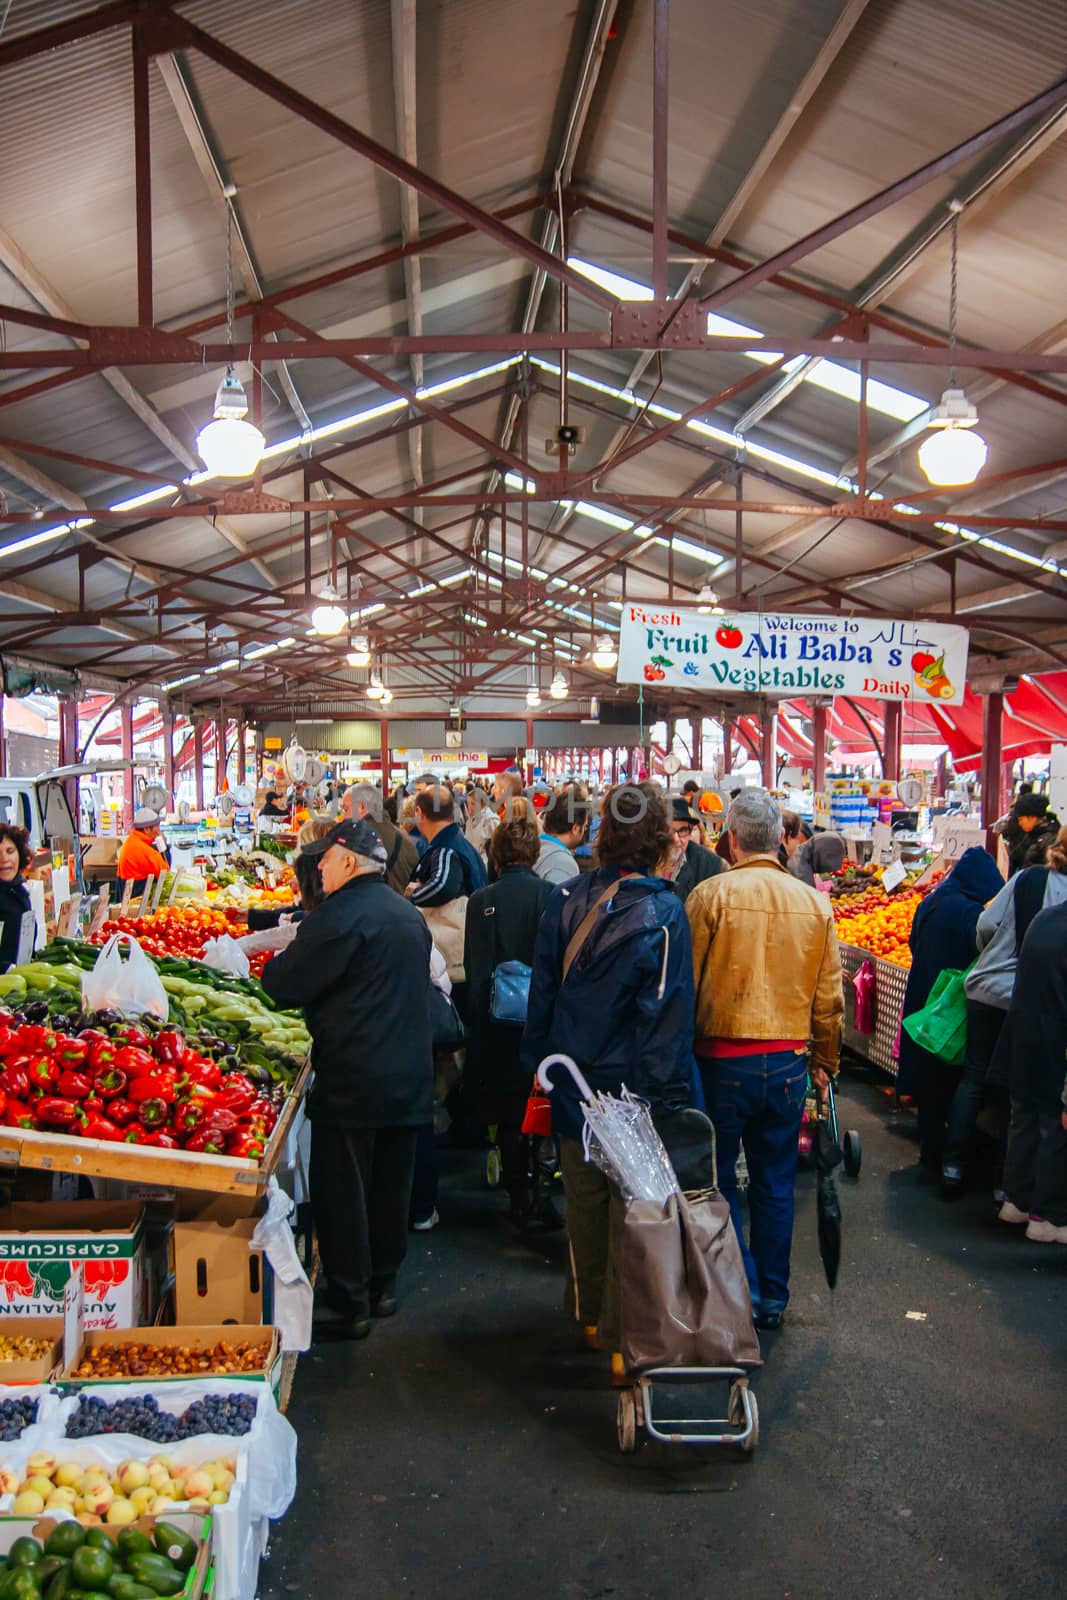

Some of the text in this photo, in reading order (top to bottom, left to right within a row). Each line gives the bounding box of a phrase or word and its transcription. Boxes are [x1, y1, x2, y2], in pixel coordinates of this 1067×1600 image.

[629, 606, 681, 626] Fresh
[764, 616, 860, 633] Welcome to
[646, 628, 709, 655] Fruit
[742, 632, 787, 660] Ali
[797, 636, 873, 664] Baba
[683, 660, 845, 692] & Vegetables
[863, 677, 911, 699] Daily
[0, 1243, 120, 1256] CAPSICUMS
[0, 1303, 117, 1315] AUSRALIAN
